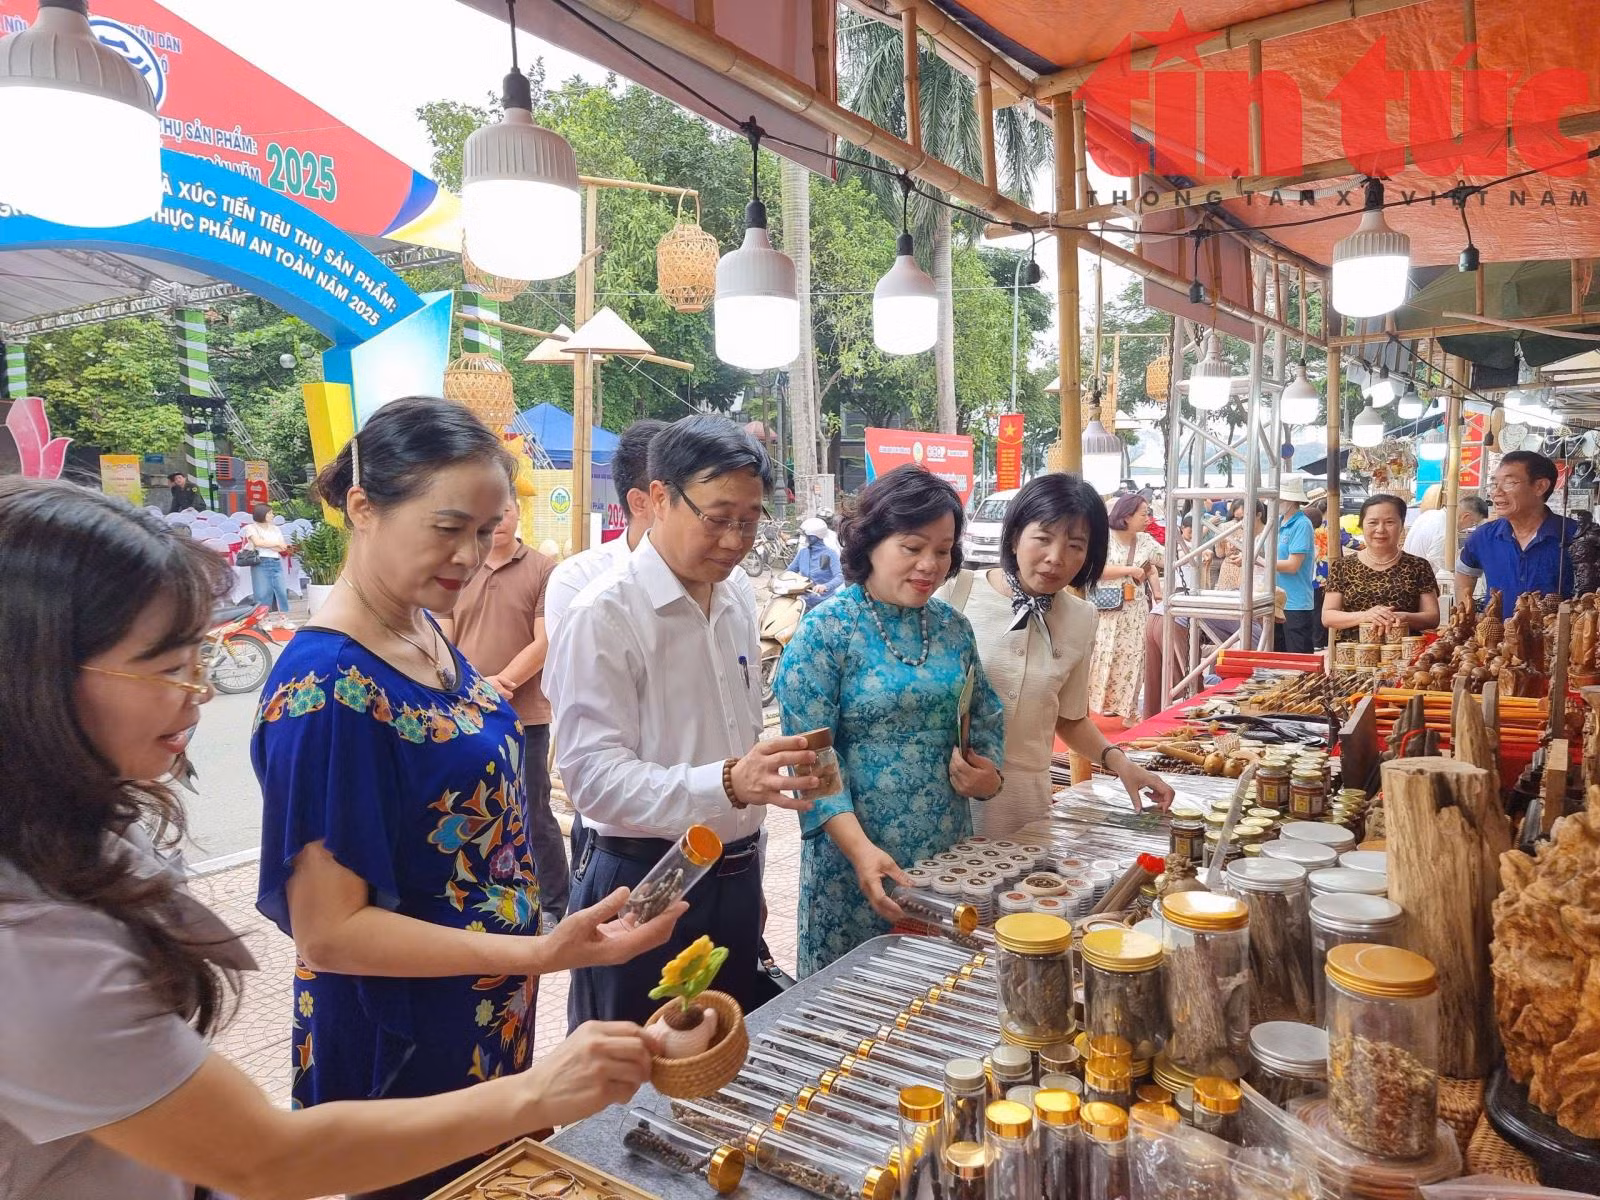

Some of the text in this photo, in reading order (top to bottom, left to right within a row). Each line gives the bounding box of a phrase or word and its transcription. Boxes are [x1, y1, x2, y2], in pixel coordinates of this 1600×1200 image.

[158, 32, 181, 52] DÂN
[186, 119, 212, 143] SẢN
[216, 126, 257, 153] PHẨM:
[266, 143, 337, 202] 2025
[178, 181, 217, 207] XÚC
[221, 195, 256, 222] TIẾN
[260, 211, 291, 238] TIÊU
[294, 228, 323, 258] THỤ
[324, 248, 354, 276] SẢN
[354, 270, 397, 313] PHẨM:
[199, 217, 246, 247] PHẨM
[249, 236, 273, 258] AN
[275, 247, 315, 280] TOÀN
[316, 271, 349, 302] NĂM
[348, 296, 381, 326] 2025
[608, 504, 628, 527] 202
